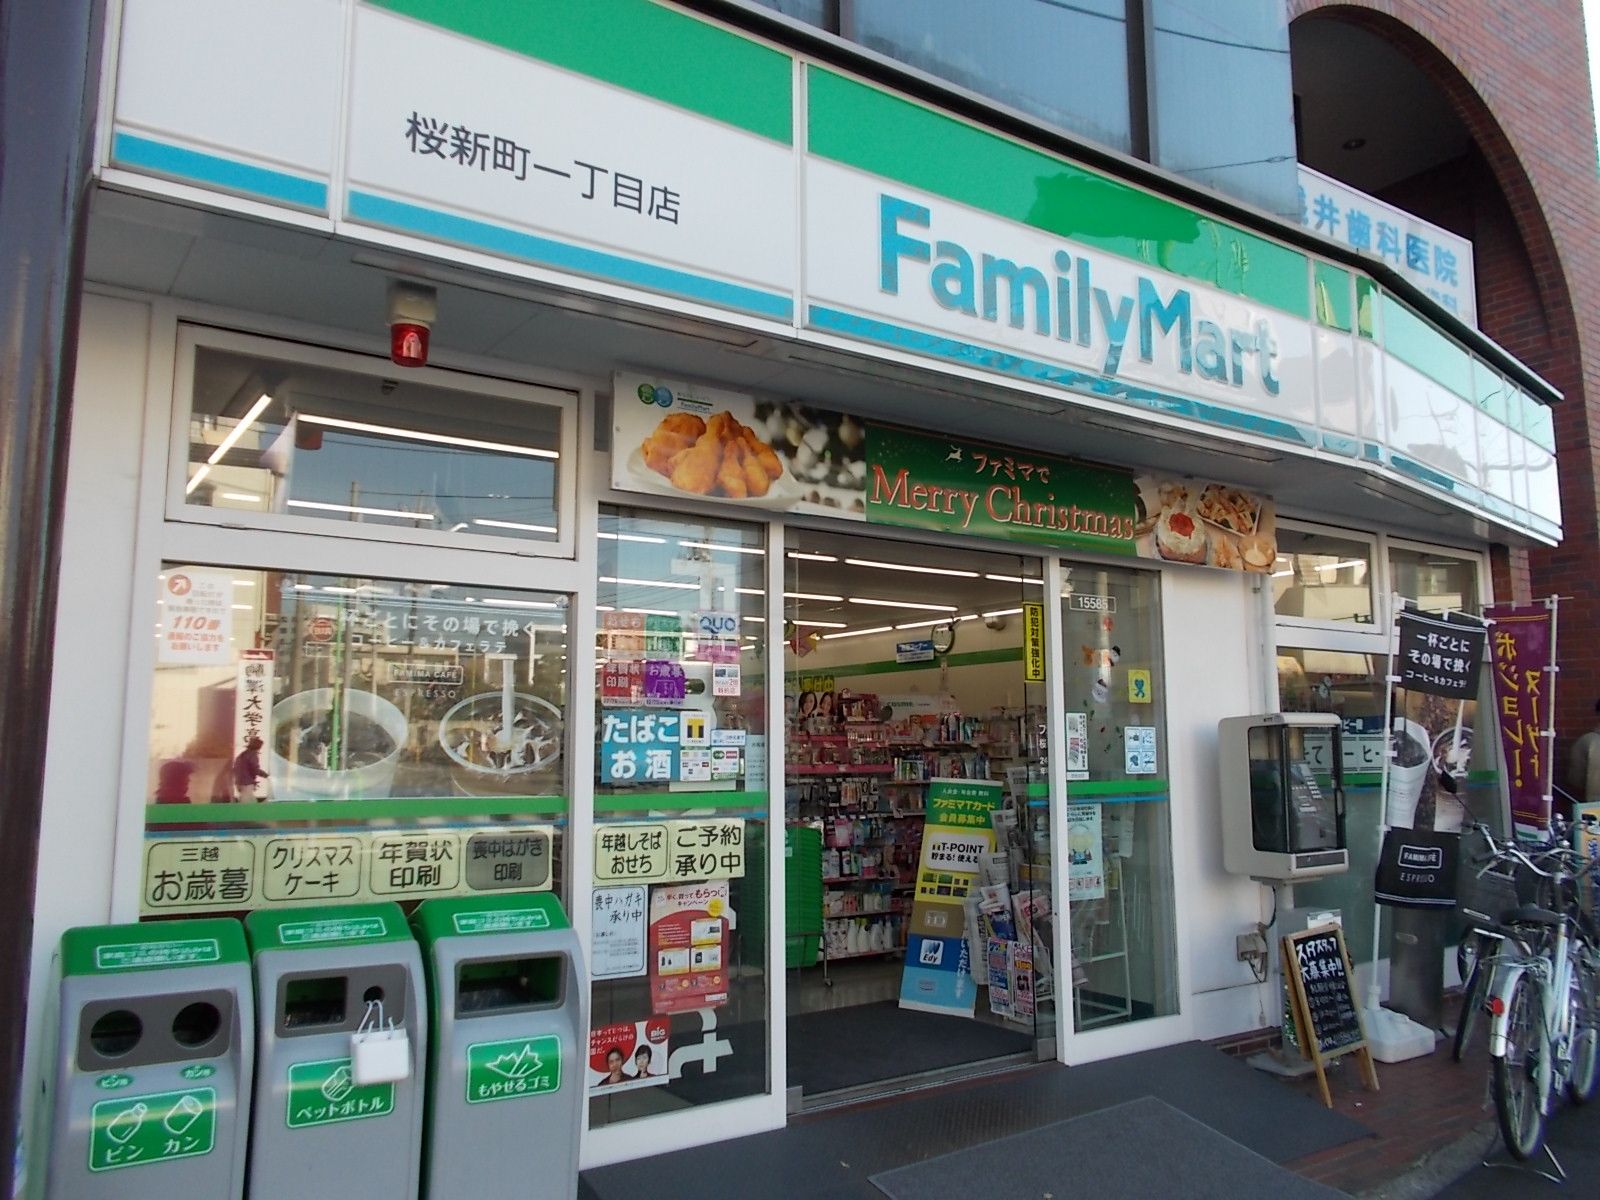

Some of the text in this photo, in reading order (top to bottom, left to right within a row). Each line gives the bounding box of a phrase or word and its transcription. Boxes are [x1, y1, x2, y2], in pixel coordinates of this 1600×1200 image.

[405, 111, 681, 225] 桜新町一丁目店
[878, 193, 1281, 397] FamilyMart
[971, 451, 1051, 485] ファミマで
[870, 464, 1135, 541] Merry Christmas
[700, 616, 736, 633] QUO
[1416, 632, 1471, 653] 一杯ごとに
[1407, 649, 1471, 673] その場で挽く
[603, 714, 680, 744] たばこ
[610, 749, 672, 779] お酒
[601, 831, 662, 852] 年越しそば
[676, 824, 742, 848] ご予約
[180, 846, 220, 862] 三越
[273, 845, 354, 870] クリスマス
[379, 840, 453, 864] 年賀状
[473, 838, 543, 859] 喪中はがき
[494, 863, 523, 881] 印刷
[611, 853, 652, 874] おせち
[675, 851, 741, 877] 承り中
[152, 867, 249, 901] お歳暮
[285, 871, 339, 895] ケーキ
[390, 865, 441, 888] 印刷
[594, 892, 643, 911] 喪中ハガキ
[609, 909, 642, 924] 承り中
[922, 954, 939, 964] Edy
[478, 1075, 550, 1097] もやせるゴミ
[296, 1096, 385, 1119] ペットボトル
[106, 1144, 144, 1163] ビン
[163, 1137, 200, 1155] カン
